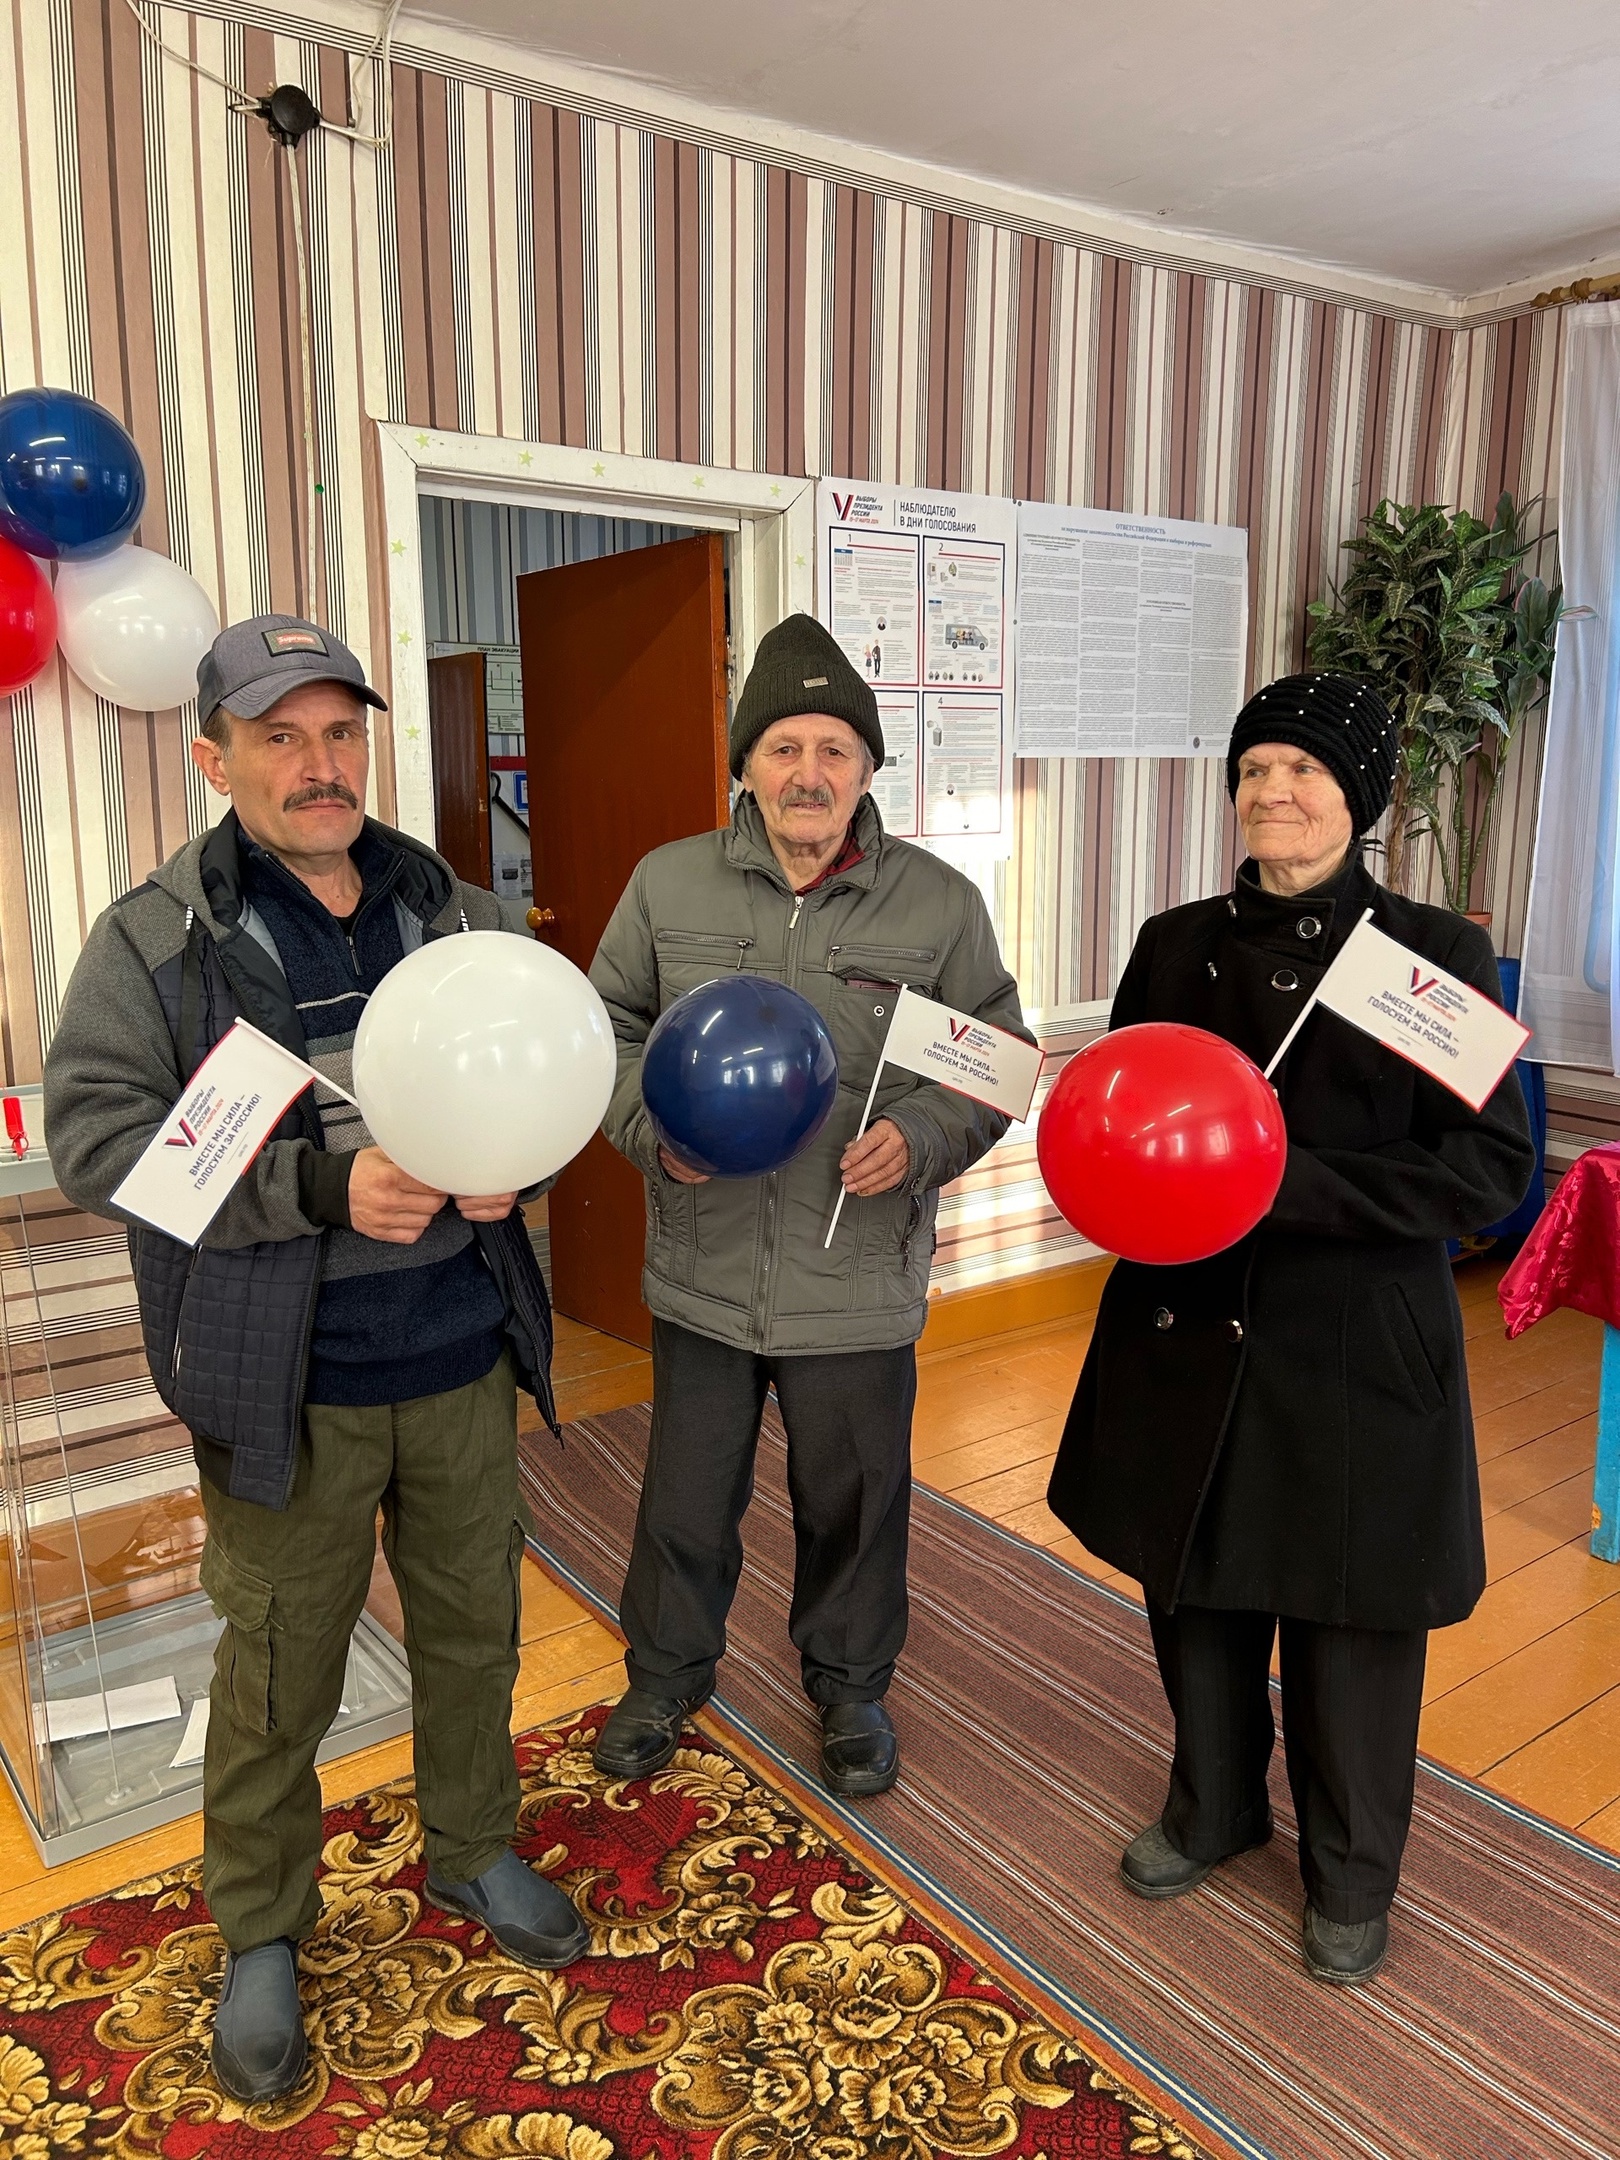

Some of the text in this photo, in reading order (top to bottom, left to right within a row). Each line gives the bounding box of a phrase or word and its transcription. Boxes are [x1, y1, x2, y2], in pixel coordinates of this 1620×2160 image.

[853, 502, 883, 511] ПРЕЗИДЕНТА
[856, 495, 877, 503] ВЫБОРЫ
[900, 501, 956, 518] НАБЛЮДАТЕЛЮ
[900, 516, 976, 533] В ДНИ ГОЛОСОВАНИЯ
[1115, 523, 1166, 535] ОТВЕТСТВЕННОСТЬ
[848, 533, 852, 543] 1
[938, 542, 944, 551] 2
[277, 636, 316, 645] Supreme
[938, 696, 944, 705] 4
[1381, 990, 1415, 1015] ВМЕСТЕ
[1414, 1010, 1431, 1026] МЫ
[1430, 1020, 1452, 1040] СИЛА
[971, 1027, 993, 1040] ВЫБОРЫ
[1367, 995, 1411, 1027] ГОЛОСУЕМ
[1410, 1022, 1422, 1034] ЗА
[1422, 1028, 1460, 1059] РОССИЮ!
[964, 1036, 983, 1048] РОССИИ
[967, 1032, 997, 1048] ПРЕЗИДЕНТА
[932, 1041, 959, 1058] ВМЕСТЕ
[960, 1052, 973, 1064] МЫ
[972, 1058, 990, 1072] СИЛА
[923, 1048, 999, 1086] ГОЛОСУЕМ ЗА РОССИЮ!
[185, 1088, 205, 1117] ВЫБОРЫ
[189, 1085, 217, 1124] ПРЕЗИДЕНТА
[193, 1105, 212, 1131] РОССИИ
[189, 1141, 216, 1176] ВМЕСТЕ
[211, 1124, 227, 1142] МЫ
[223, 1101, 242, 1125] СИЛА
[194, 1093, 262, 1190] ГОЛОСУЕМ ЗА РОССИЮ!
